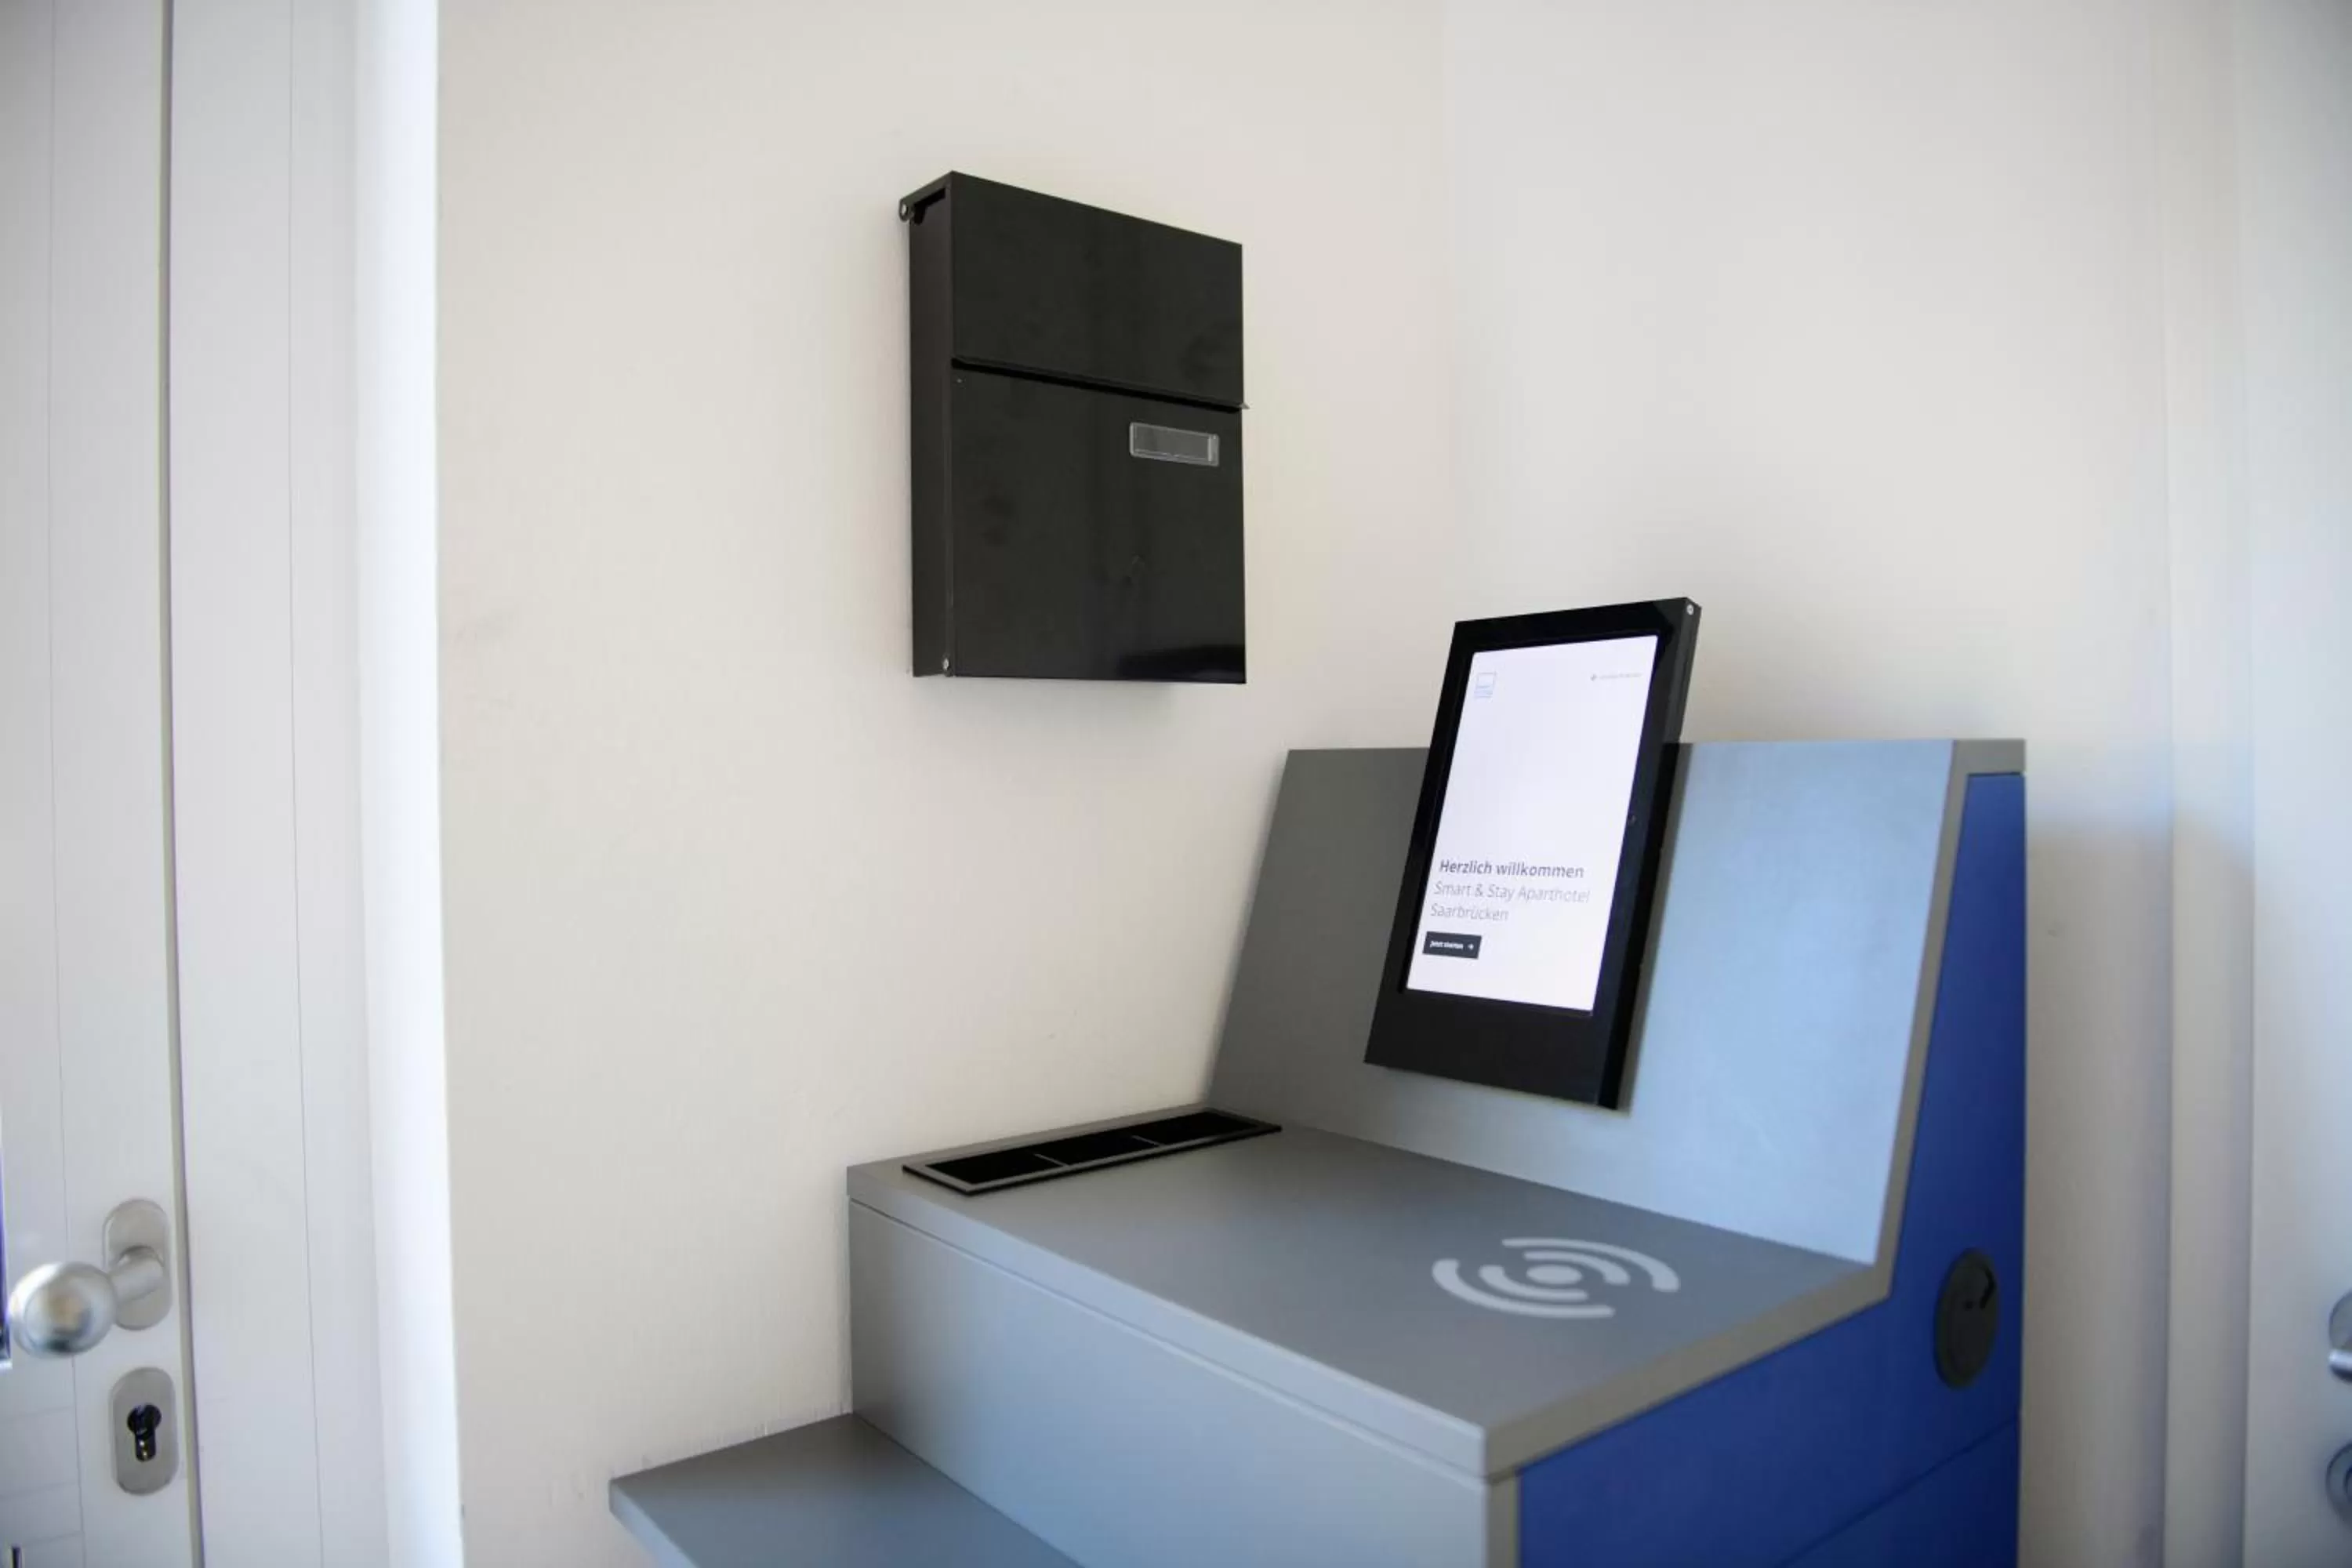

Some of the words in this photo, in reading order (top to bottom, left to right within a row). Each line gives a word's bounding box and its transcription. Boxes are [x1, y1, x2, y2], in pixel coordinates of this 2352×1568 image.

[1439, 859, 1492, 875] Herzlich
[1497, 862, 1584, 878] willkommen
[1434, 880, 1471, 897] Smart
[1475, 884, 1484, 898] &
[1487, 884, 1515, 901] Stay
[1518, 887, 1590, 903] Aparthotel
[1431, 903, 1509, 920] Saarbrücken
